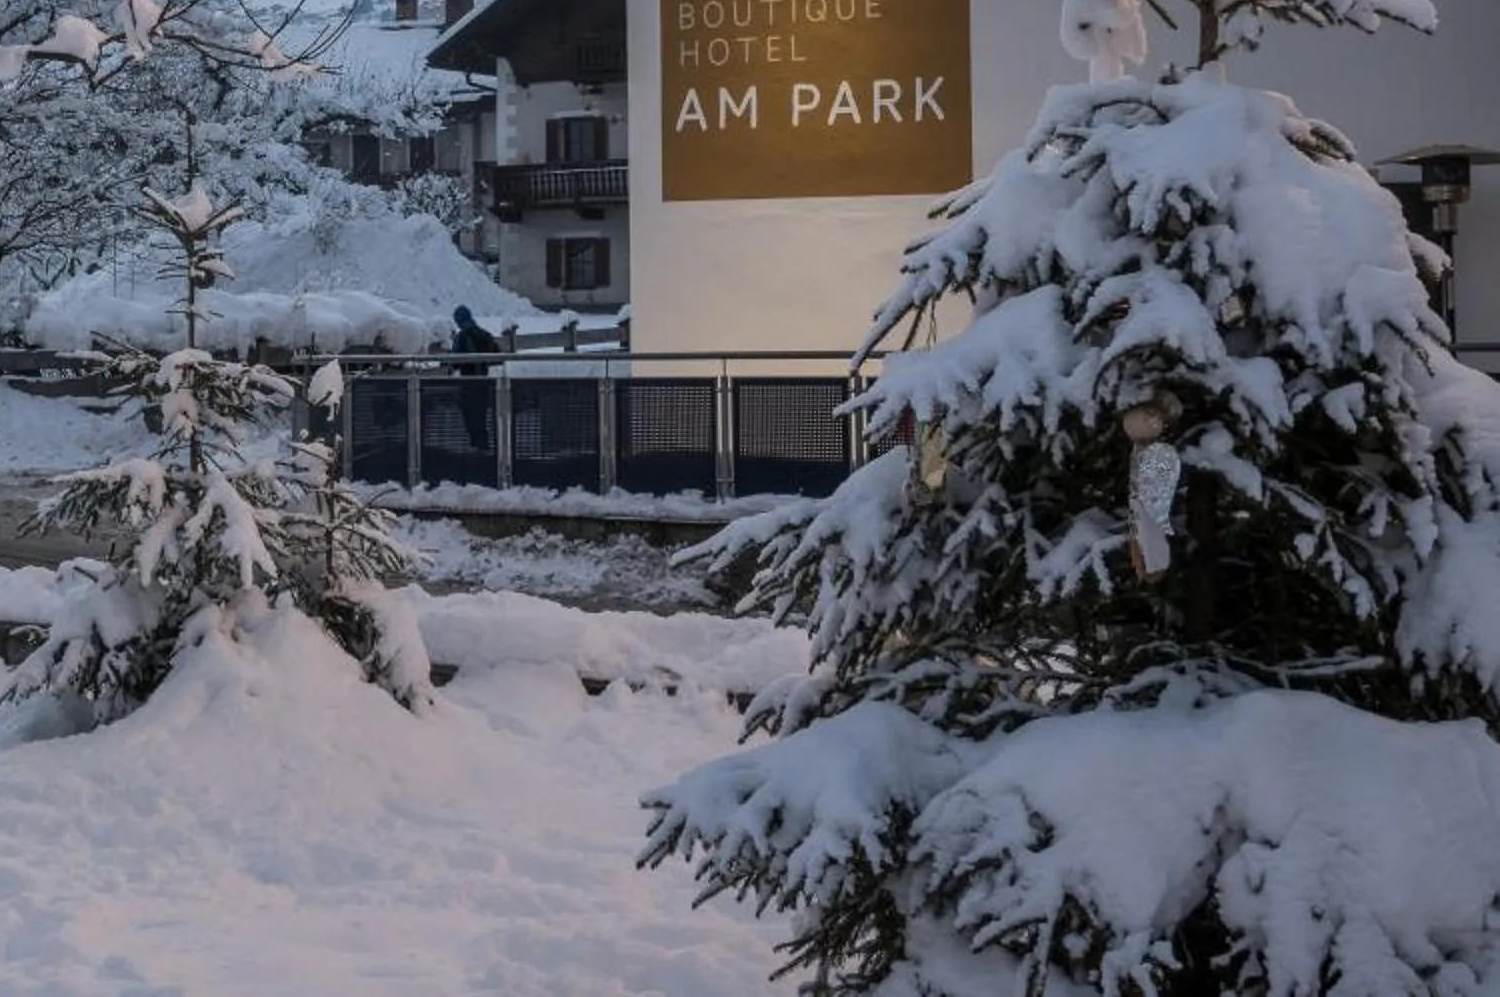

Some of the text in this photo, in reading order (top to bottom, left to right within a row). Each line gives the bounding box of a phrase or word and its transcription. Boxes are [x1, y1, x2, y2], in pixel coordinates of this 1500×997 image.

[679, 35, 808, 66] HOTEL
[676, 77, 946, 132] AM PARK
